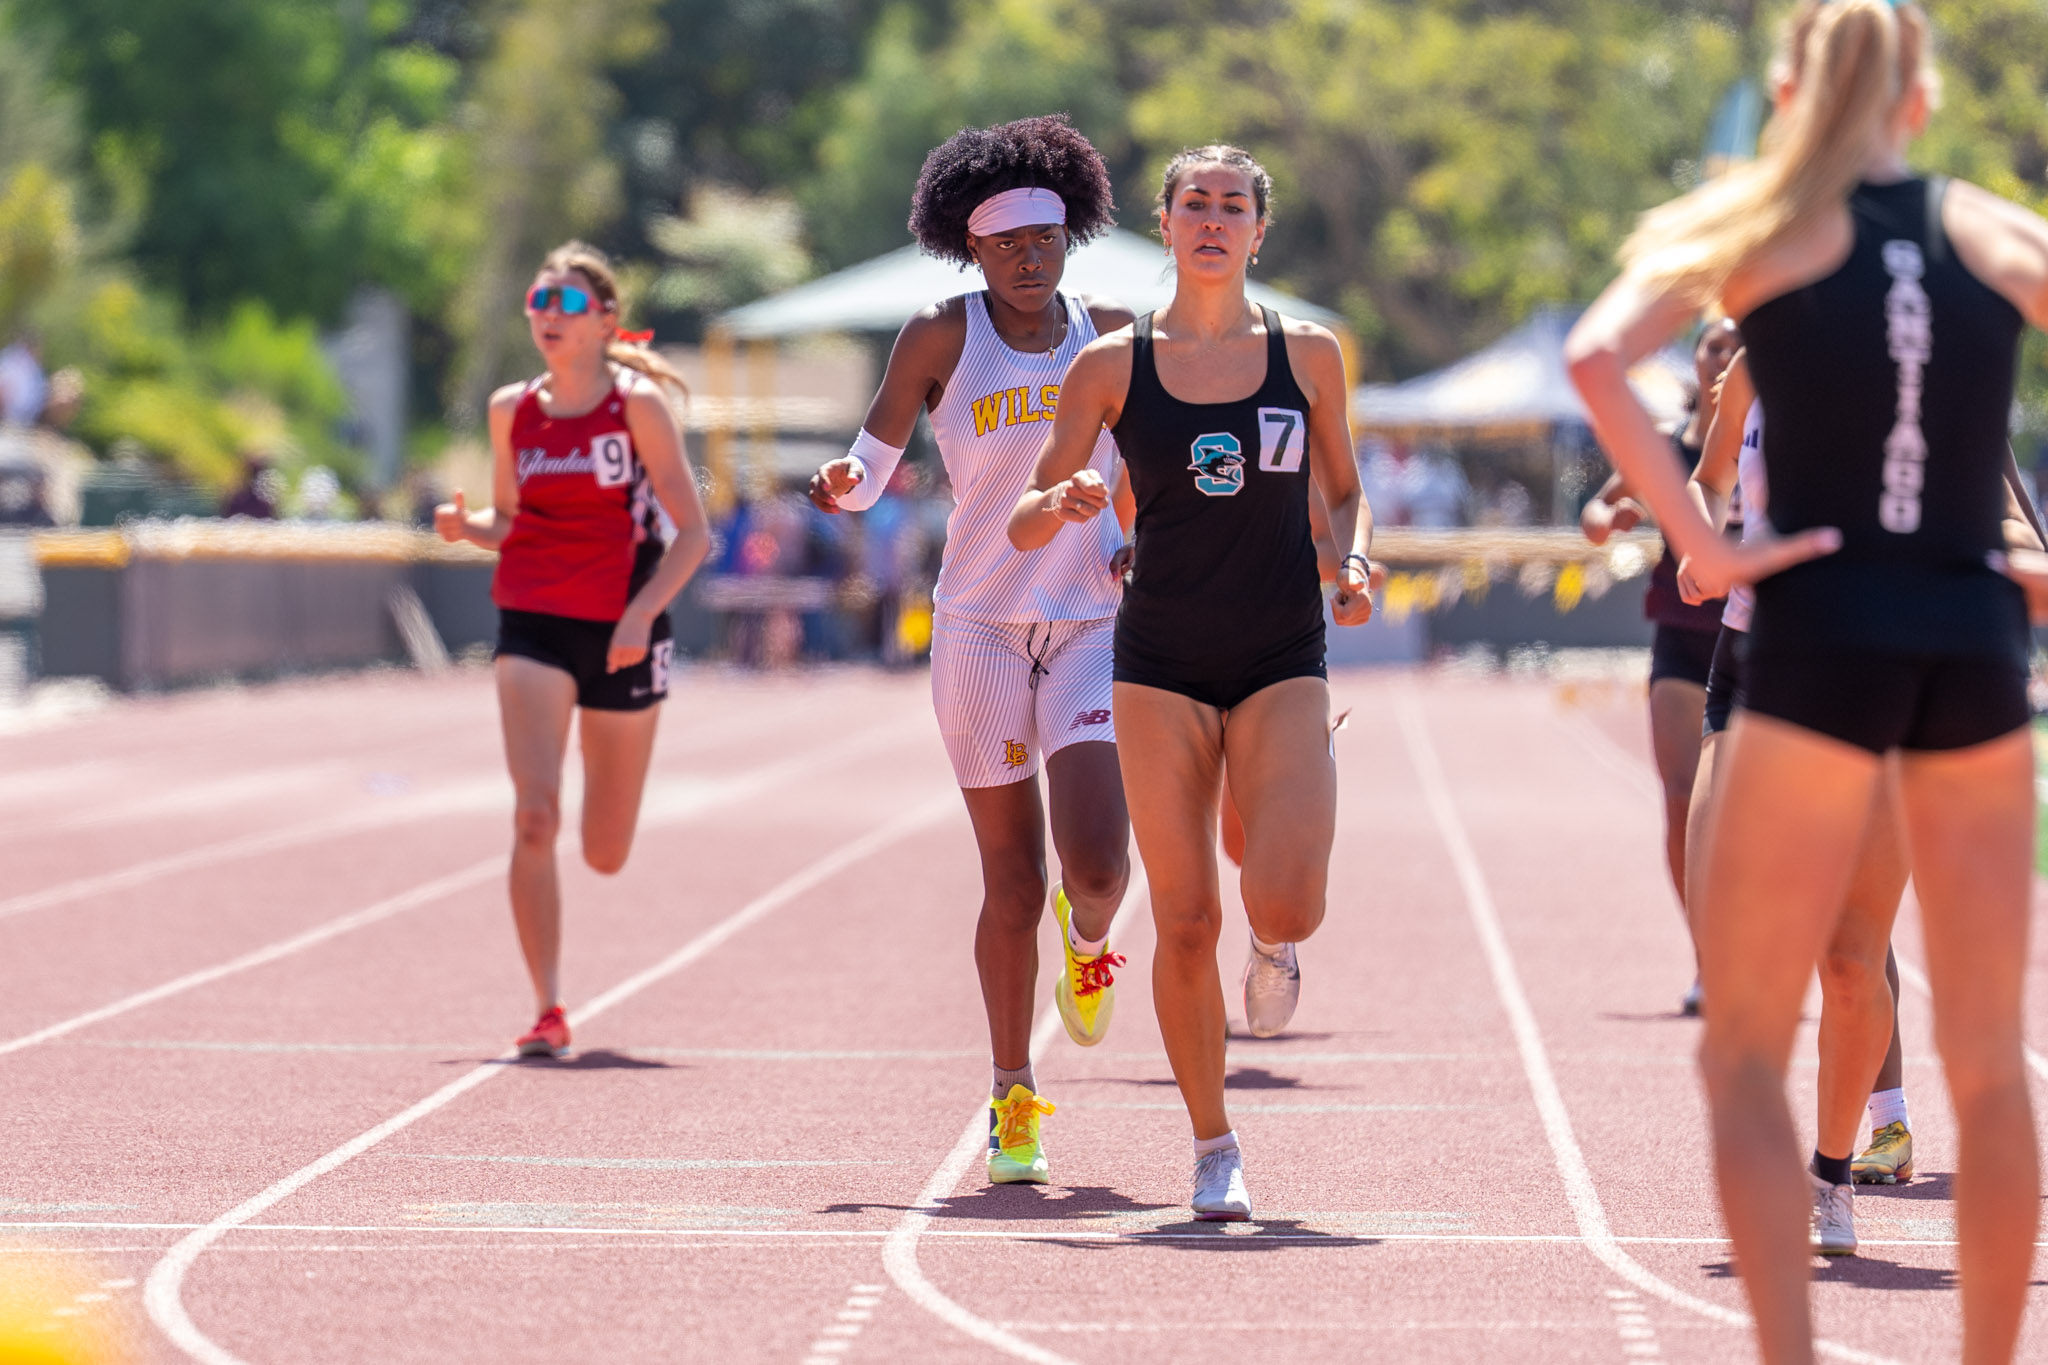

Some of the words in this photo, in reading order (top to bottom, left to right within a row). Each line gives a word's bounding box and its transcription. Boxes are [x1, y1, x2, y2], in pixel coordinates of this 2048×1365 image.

[971, 384, 1061, 437] WILS
[603, 438, 624, 481] 9
[1264, 413, 1296, 466] 7
[518, 446, 595, 487] Glenda
